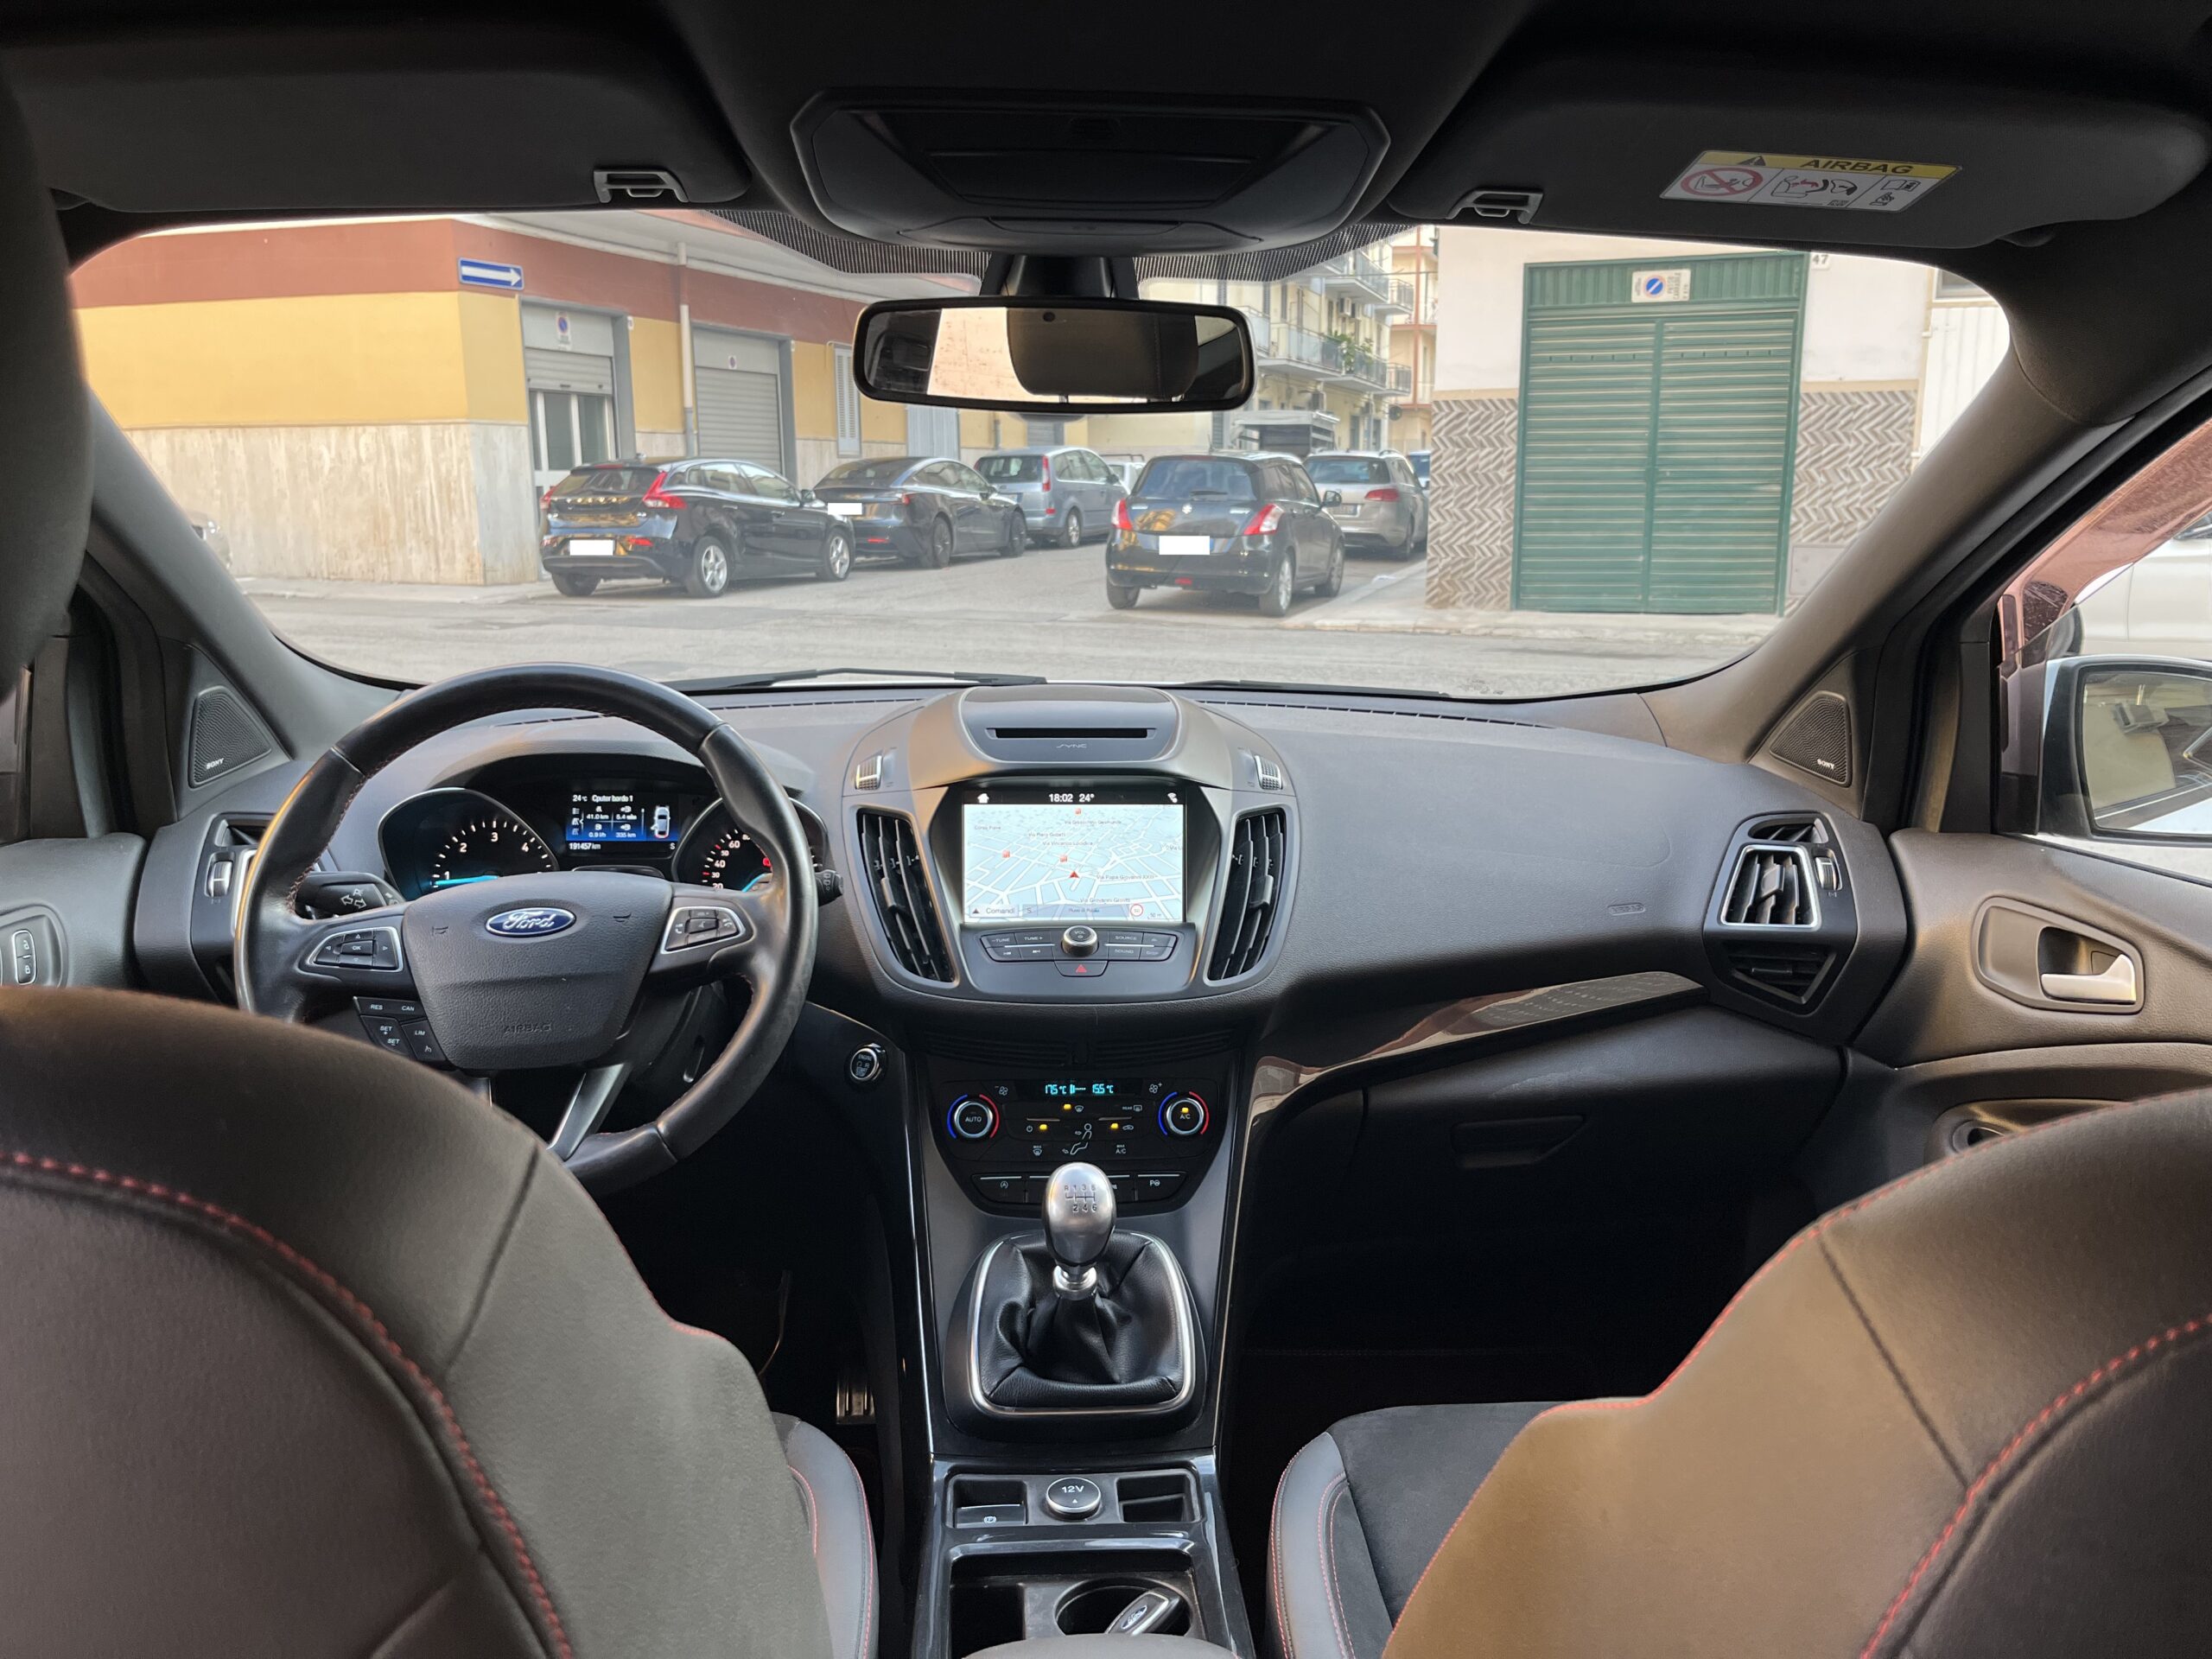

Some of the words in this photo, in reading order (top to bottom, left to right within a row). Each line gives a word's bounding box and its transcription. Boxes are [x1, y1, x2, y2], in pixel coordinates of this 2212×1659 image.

[1800, 159, 1913, 174] AIRBAG
[1812, 254, 1829, 264] 47
[207, 758, 224, 769] SONY
[1817, 759, 1834, 769] SONY
[1049, 793, 1073, 803] 18:02
[1078, 793, 1095, 803] 24°
[491, 832, 499, 842] 3
[460, 842, 467, 853] 2
[521, 842, 529, 853] 4
[714, 860, 726, 868] 40
[444, 871, 450, 880] 1
[502, 911, 556, 930] Ford
[1073, 1204, 1079, 1212] 2
[1083, 1204, 1088, 1212] 4
[1091, 1204, 1097, 1212] 6
